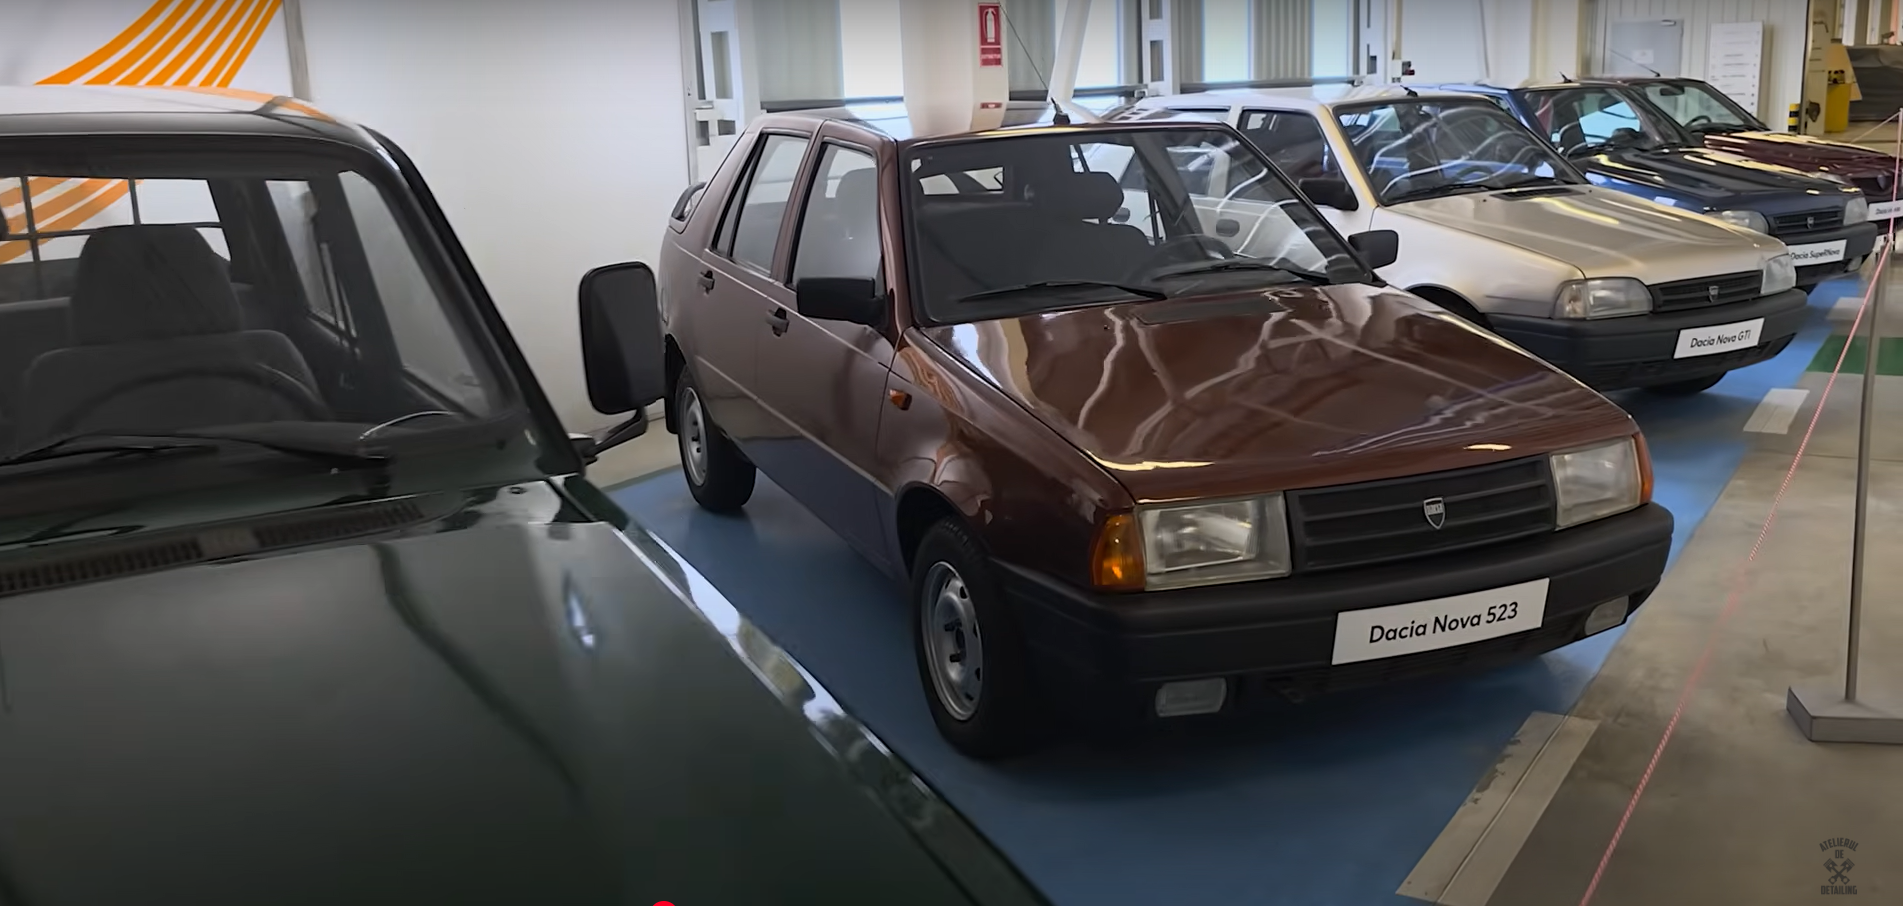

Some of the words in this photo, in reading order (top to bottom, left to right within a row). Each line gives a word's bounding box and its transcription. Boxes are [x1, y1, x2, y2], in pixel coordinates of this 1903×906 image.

[1690, 336, 1716, 348] Dacia
[1716, 334, 1737, 345] Nova
[1369, 620, 1427, 643] Dacia
[1432, 615, 1482, 634] Nova
[1486, 601, 1518, 624] 523
